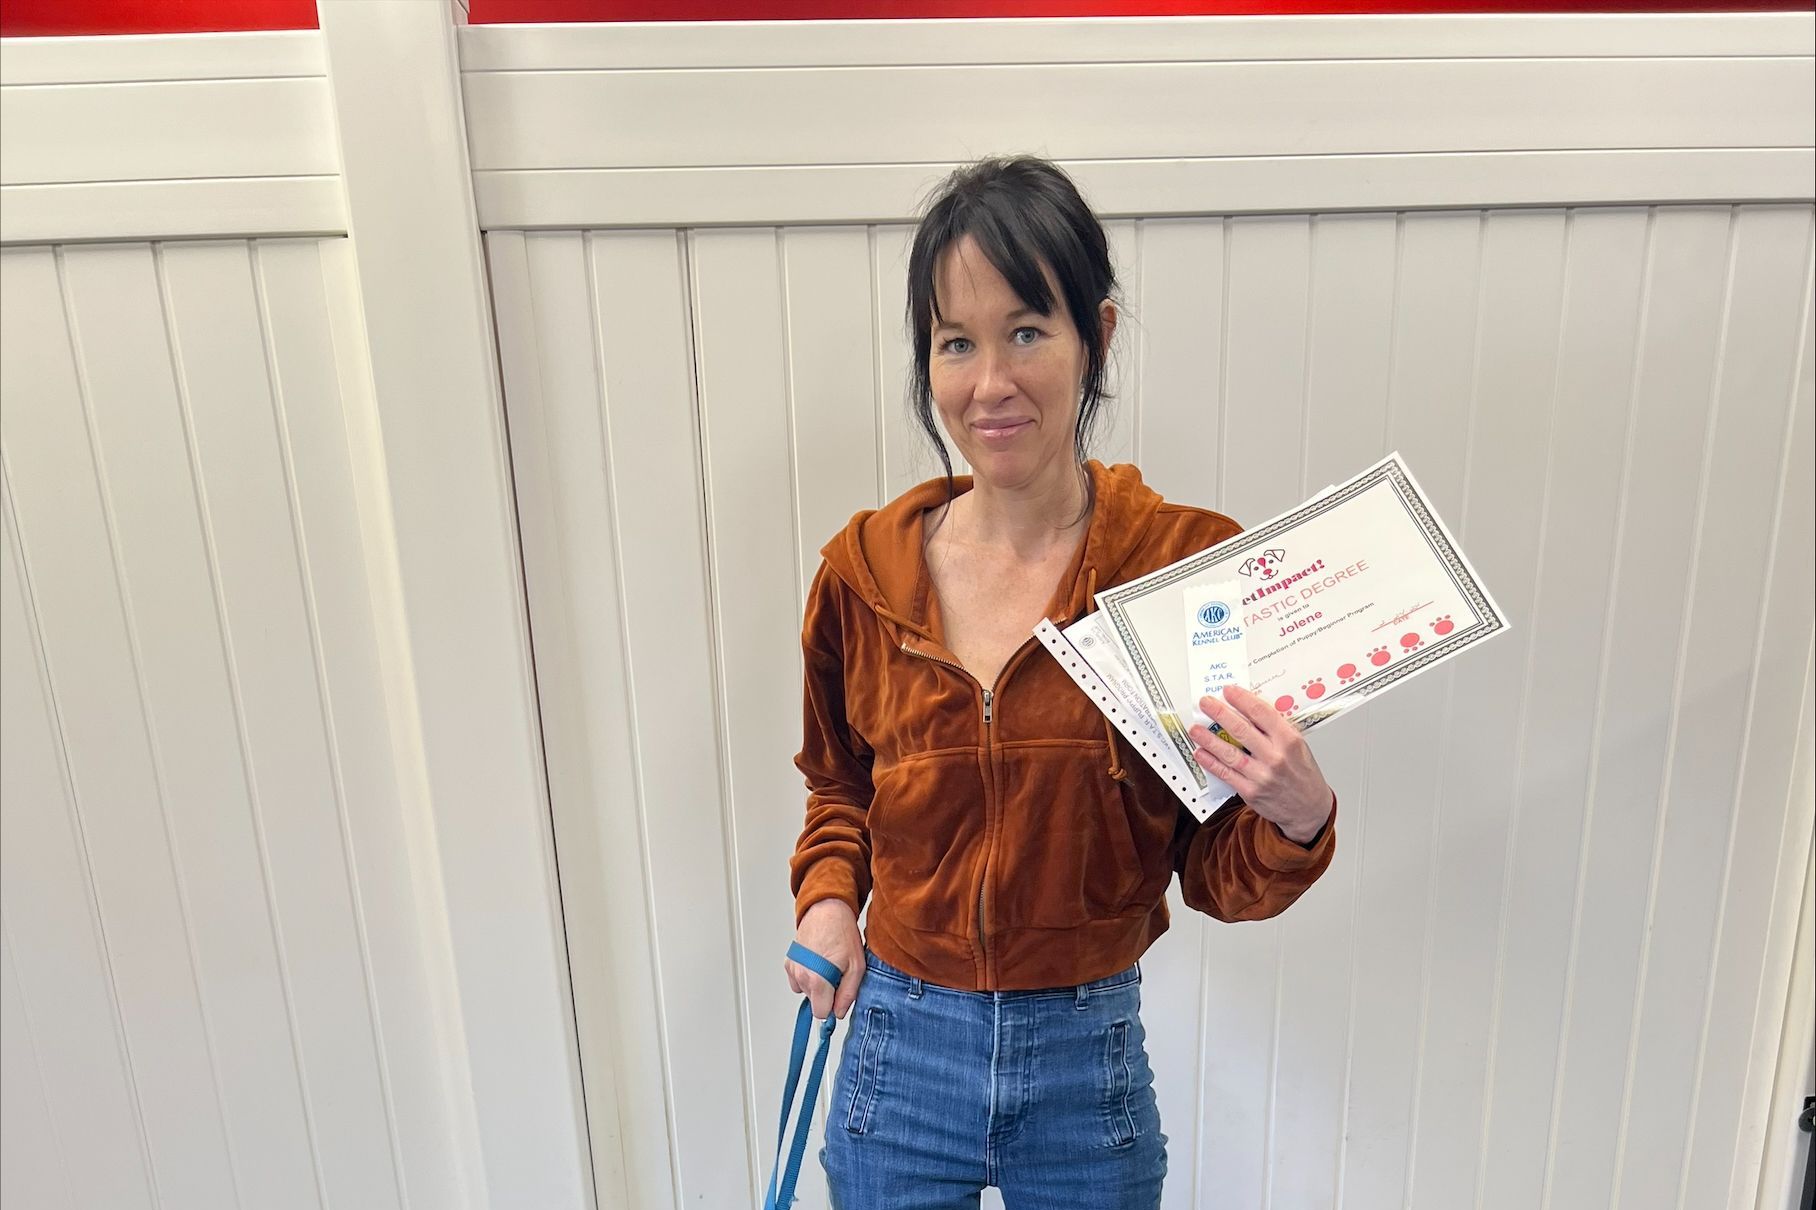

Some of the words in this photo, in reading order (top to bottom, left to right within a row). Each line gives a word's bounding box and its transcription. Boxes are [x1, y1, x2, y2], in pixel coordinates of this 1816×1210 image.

[1242, 559, 1325, 605] etImpact!
[1243, 595, 1297, 627] TASTIC
[1300, 560, 1369, 600] DEGREE
[1203, 606, 1224, 623] AKC
[1285, 608, 1302, 619] given
[1279, 611, 1323, 637] Jolene
[1192, 637, 1219, 646] KENNEL
[1193, 627, 1240, 640] AMERICAN
[1253, 645, 1289, 664] Completion
[1297, 616, 1346, 642] Puppy/Beginner
[1347, 602, 1375, 618] Program
[1210, 662, 1227, 670] AKC
